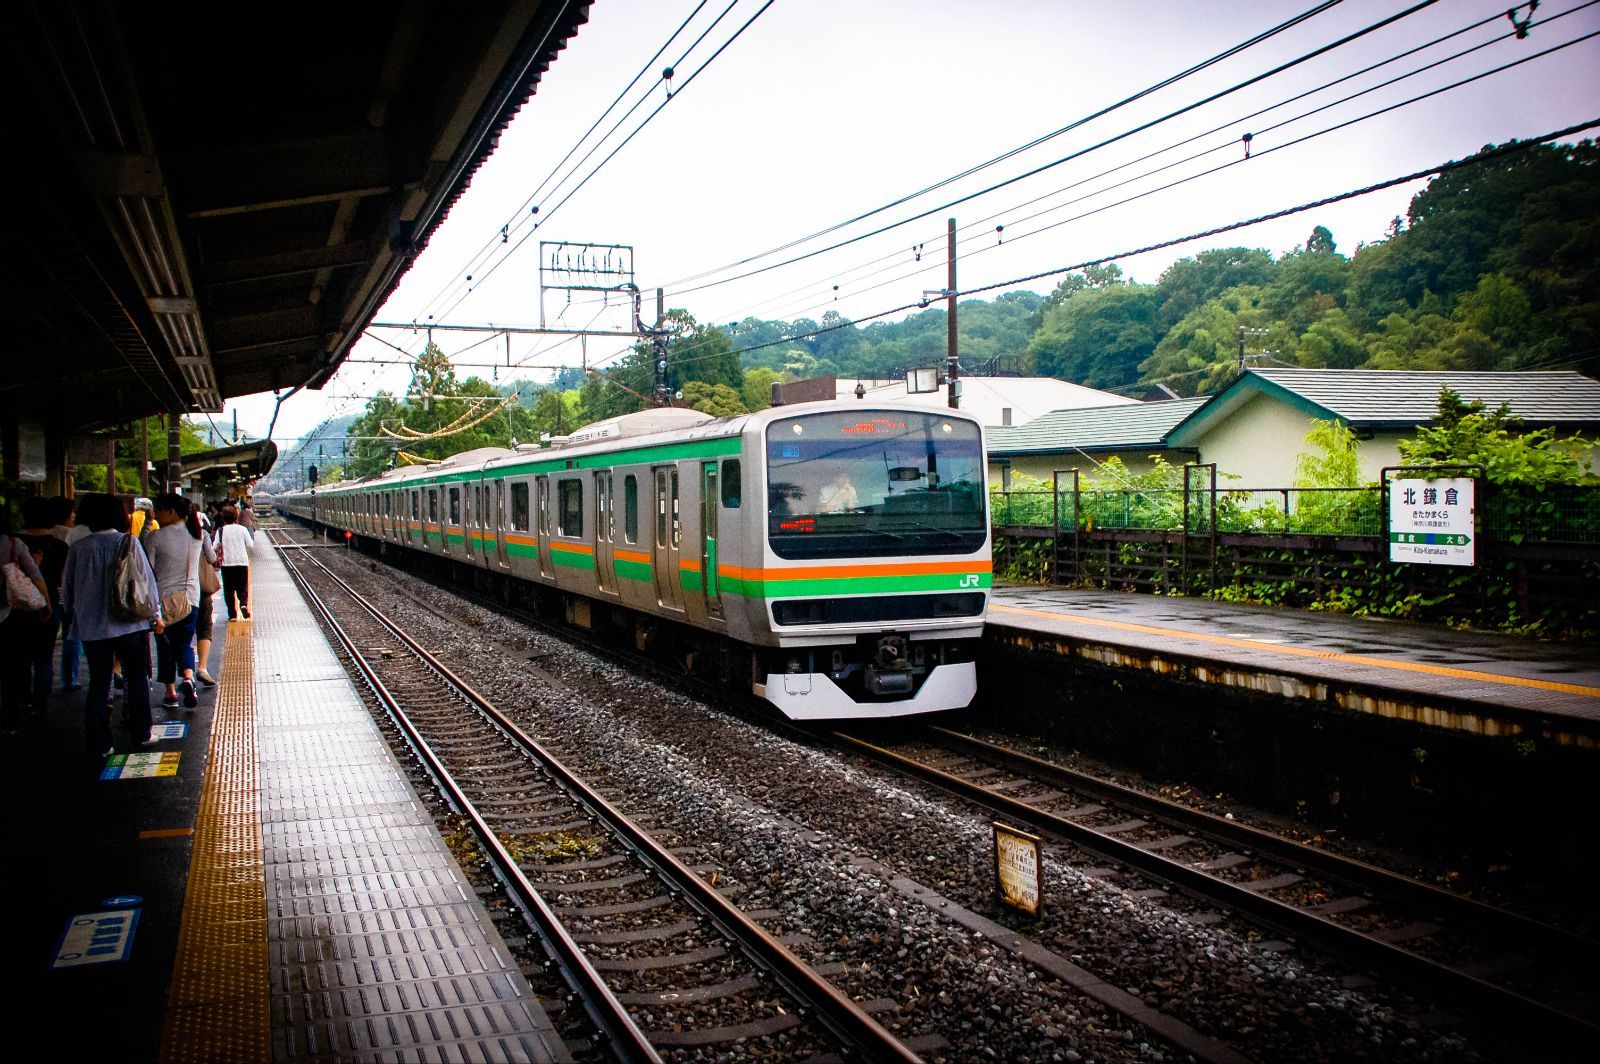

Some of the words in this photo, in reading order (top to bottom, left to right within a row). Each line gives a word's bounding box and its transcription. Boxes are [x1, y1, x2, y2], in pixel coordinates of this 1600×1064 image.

[1403, 488, 1458, 505] 北鎌倉
[1412, 510, 1448, 518] きたかまくら
[959, 574, 980, 588] JR
